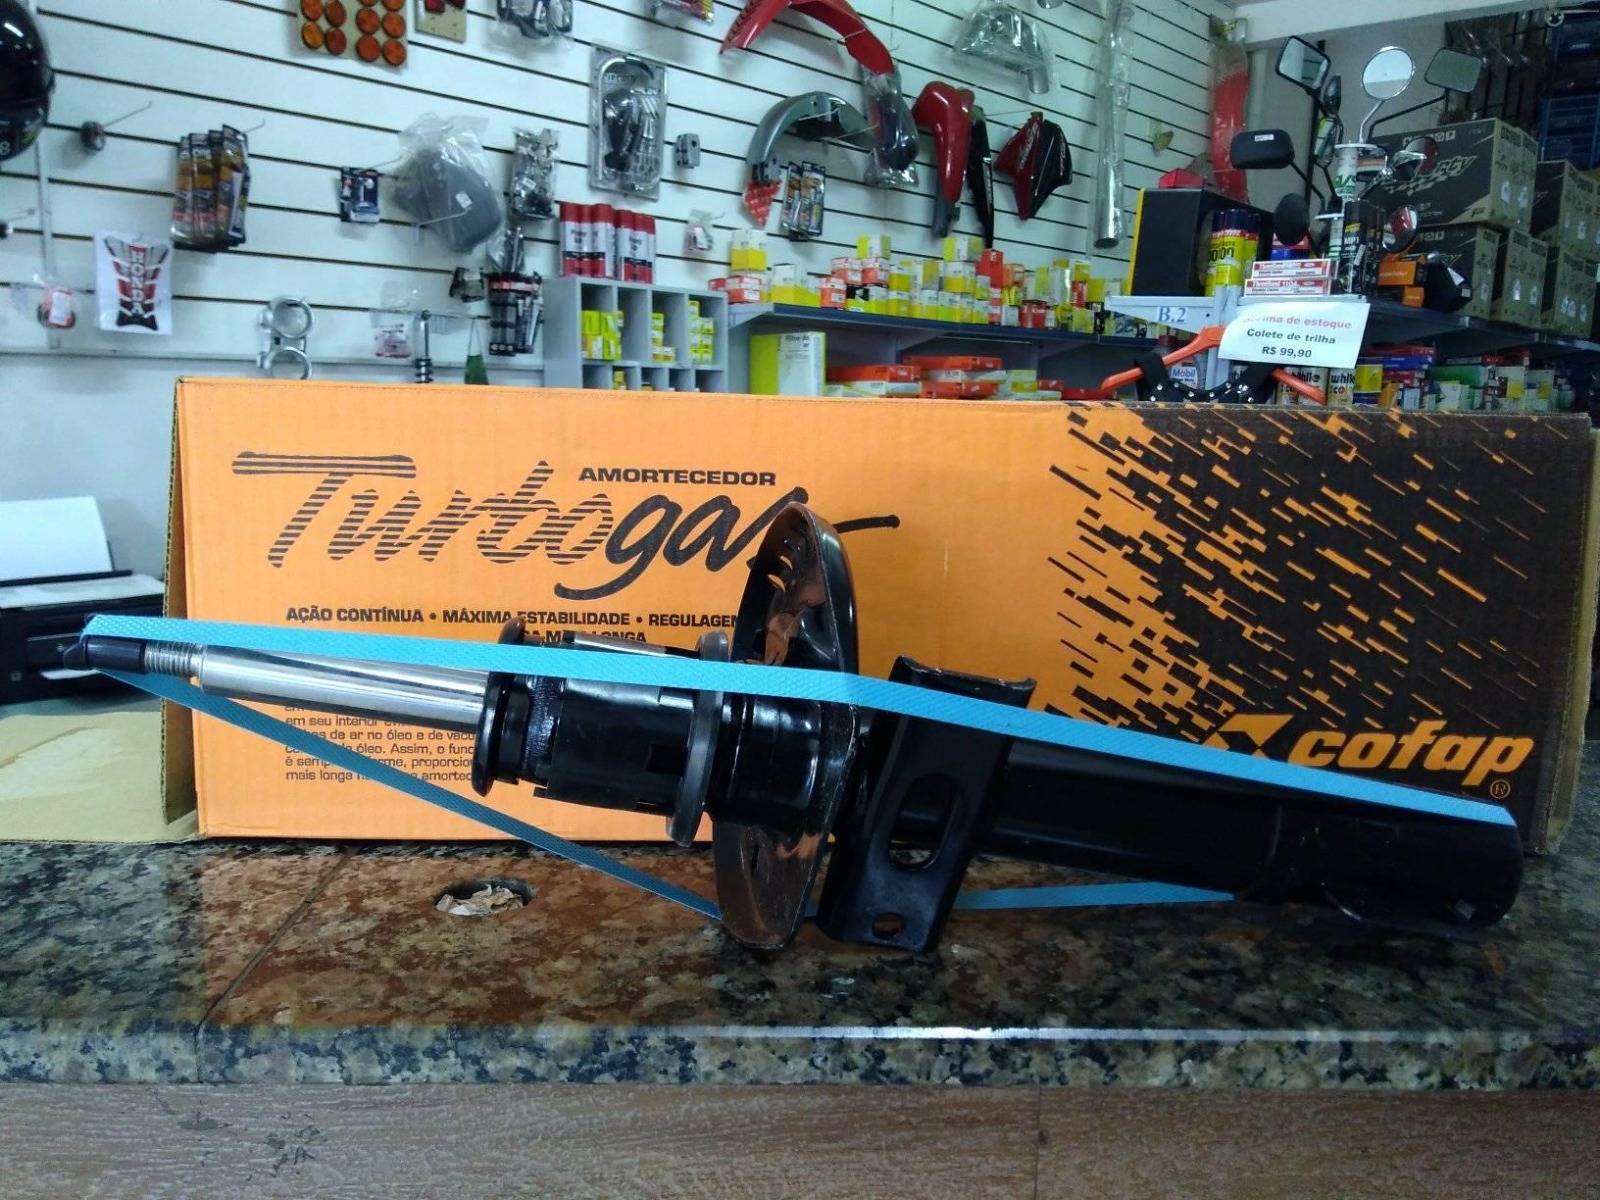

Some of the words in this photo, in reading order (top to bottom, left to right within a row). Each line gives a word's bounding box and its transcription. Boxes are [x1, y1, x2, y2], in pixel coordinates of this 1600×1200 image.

[130, 251, 145, 315] HONDA
[1158, 306, 1187, 322] B.2
[1286, 316, 1301, 325] de
[1304, 318, 1352, 329] estoque
[1247, 328, 1283, 339] Colete
[1287, 332, 1301, 341] de
[1305, 334, 1336, 344] trilha
[1262, 346, 1277, 355] R$
[1280, 347, 1312, 358] 99,90
[1173, 368, 1196, 377] Mobil
[578, 467, 776, 487] AMORTECEDOR
[286, 605, 333, 623] AÇÃO
[337, 606, 424, 623] CONTÍNUA
[443, 607, 512, 624] MÁXIMA
[518, 610, 630, 625] ESTABILIDADE
[309, 716, 332, 726] seu
[330, 729, 346, 740] de
[350, 732, 363, 740] ar
[367, 732, 383, 740] no
[386, 730, 412, 741] óleo
[416, 731, 425, 740] e
[428, 729, 443, 741] de
[356, 743, 386, 754] óleo.
[390, 743, 433, 755] Assim,
[437, 746, 445, 754] o
[1287, 719, 1535, 786] cofap
[285, 756, 293, 767] é
[411, 756, 473, 769] proporcio
[286, 769, 316, 780] mais
[320, 769, 353, 783] longa
